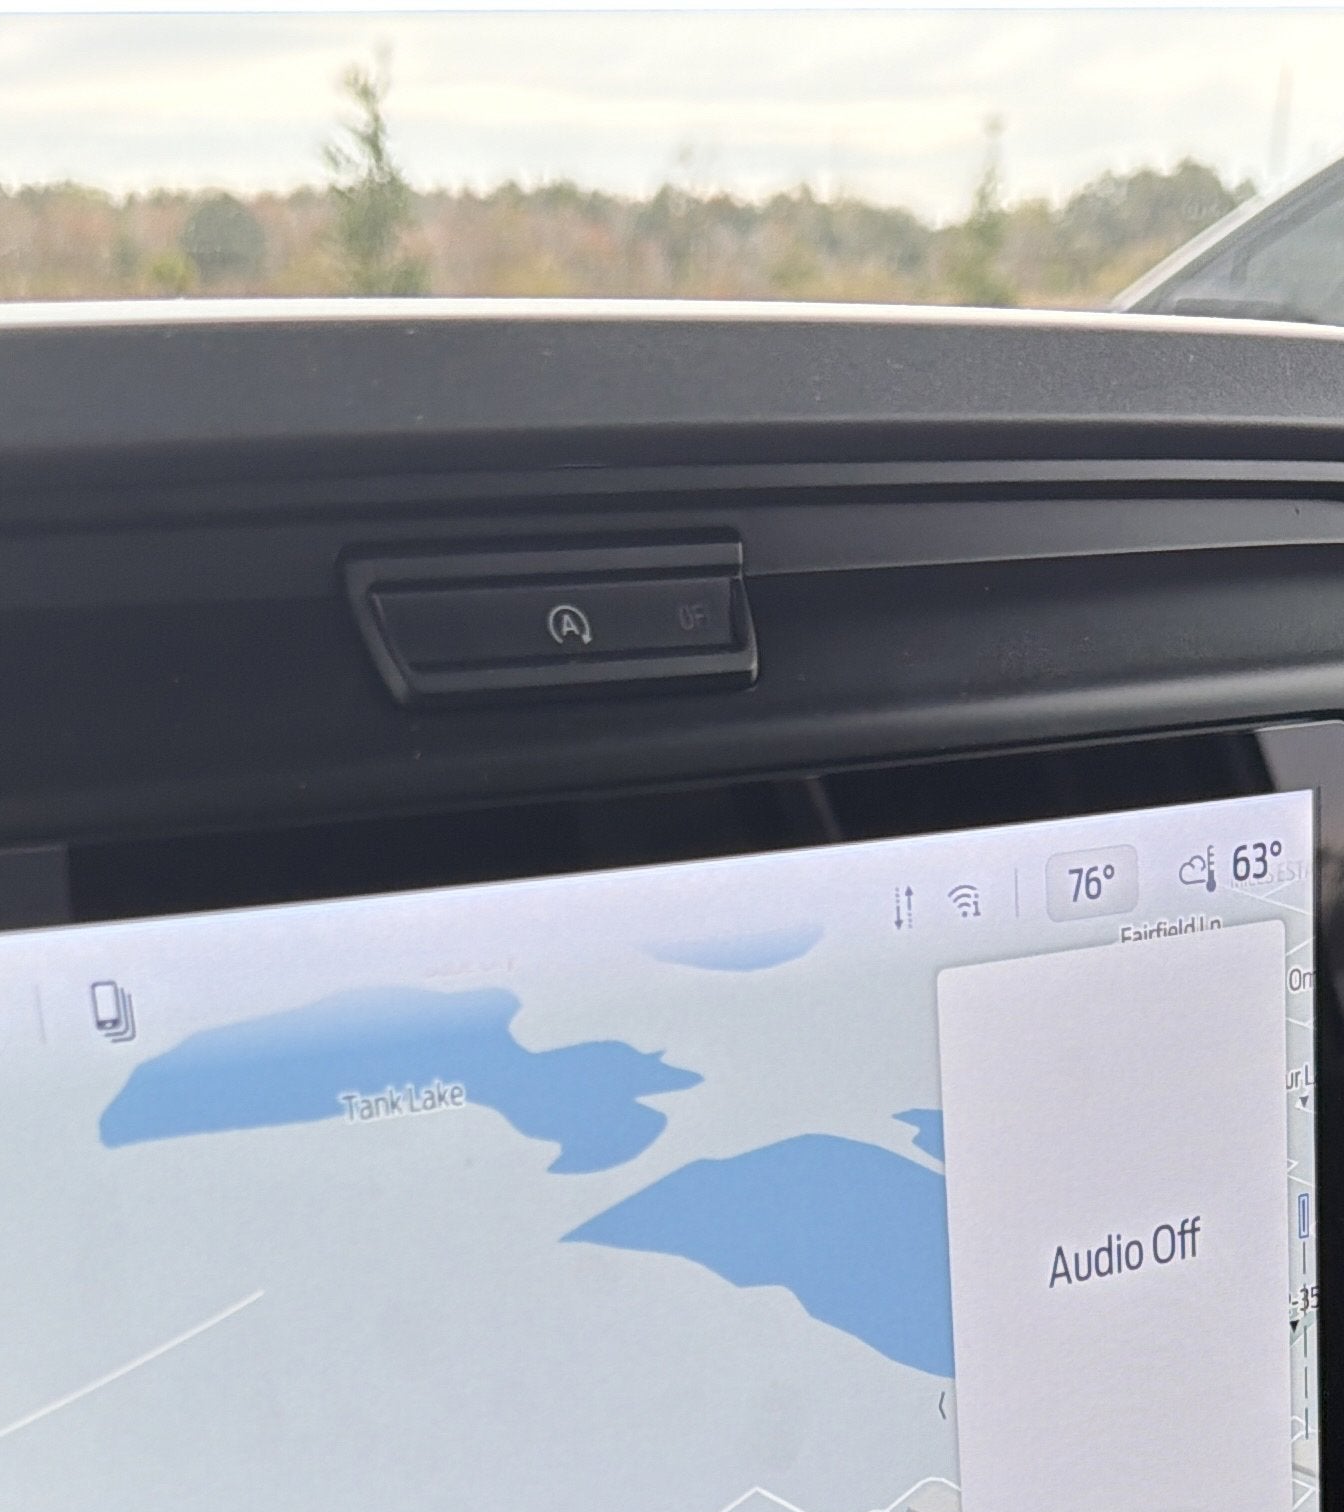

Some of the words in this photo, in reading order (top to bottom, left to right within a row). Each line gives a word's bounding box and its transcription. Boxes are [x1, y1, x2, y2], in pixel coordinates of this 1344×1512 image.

[1232, 840, 1282, 882] 63°
[1068, 864, 1115, 902] 76°
[342, 1089, 402, 1121] Tank
[407, 1082, 464, 1113] Lake
[1048, 1234, 1145, 1289] Audio
[1152, 1216, 1202, 1265] Off
